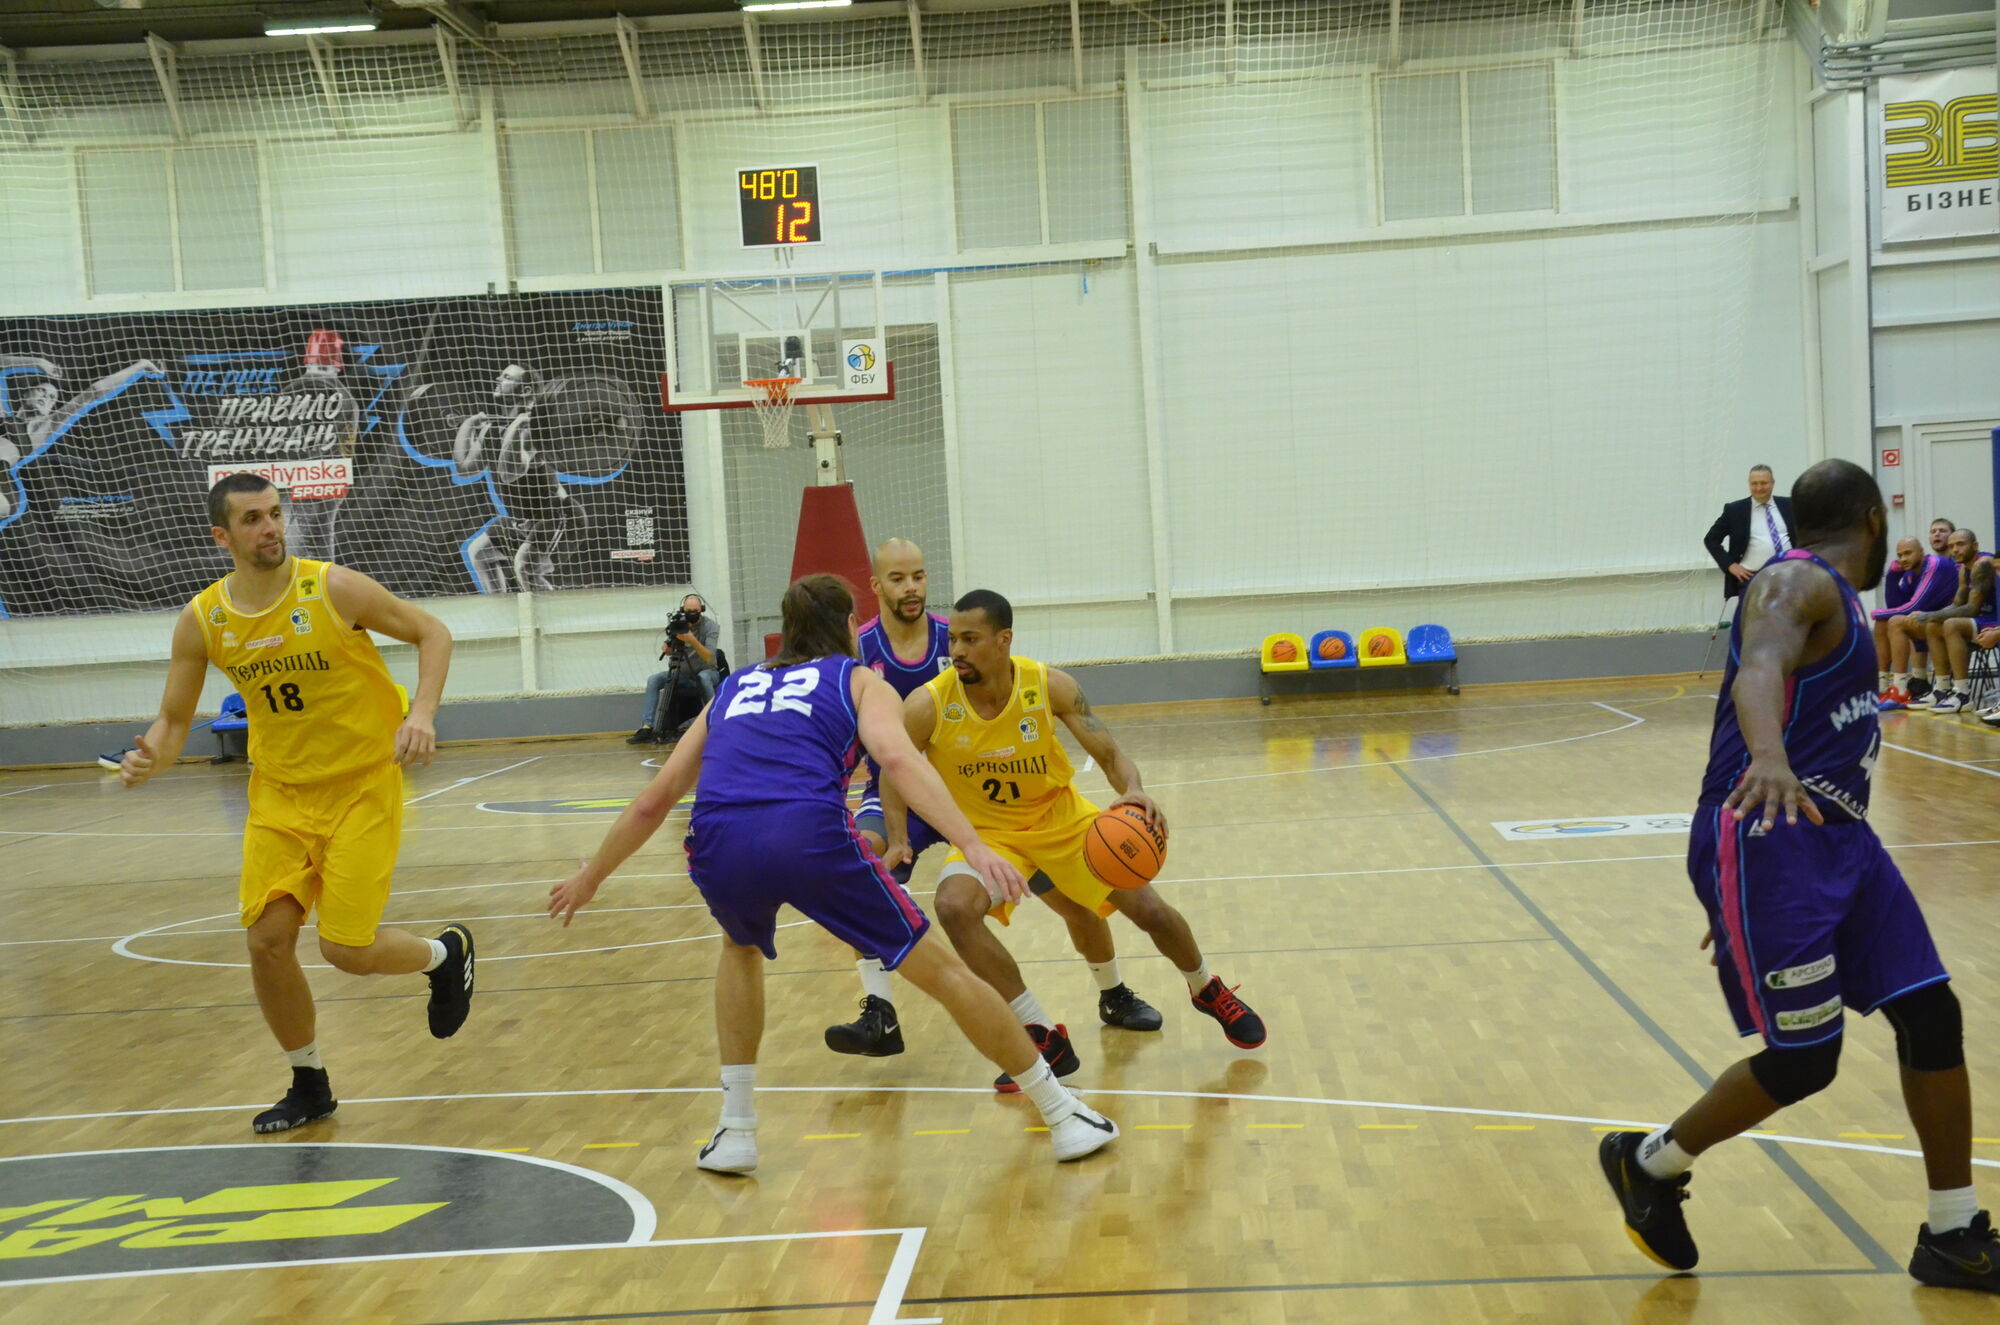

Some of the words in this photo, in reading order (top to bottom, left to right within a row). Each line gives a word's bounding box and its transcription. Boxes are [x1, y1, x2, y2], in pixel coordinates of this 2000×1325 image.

[1907, 188, 2000, 212] БІЗНЕ
[776, 201, 811, 242] 12
[851, 374, 875, 384] ФБУ
[215, 392, 343, 425] ПРАВИЛО
[181, 423, 337, 458] ТРЕНУВАНЬ
[294, 484, 345, 498] SPORT
[260, 682, 304, 713] 18
[724, 667, 820, 720] 22
[982, 778, 1020, 804] 21
